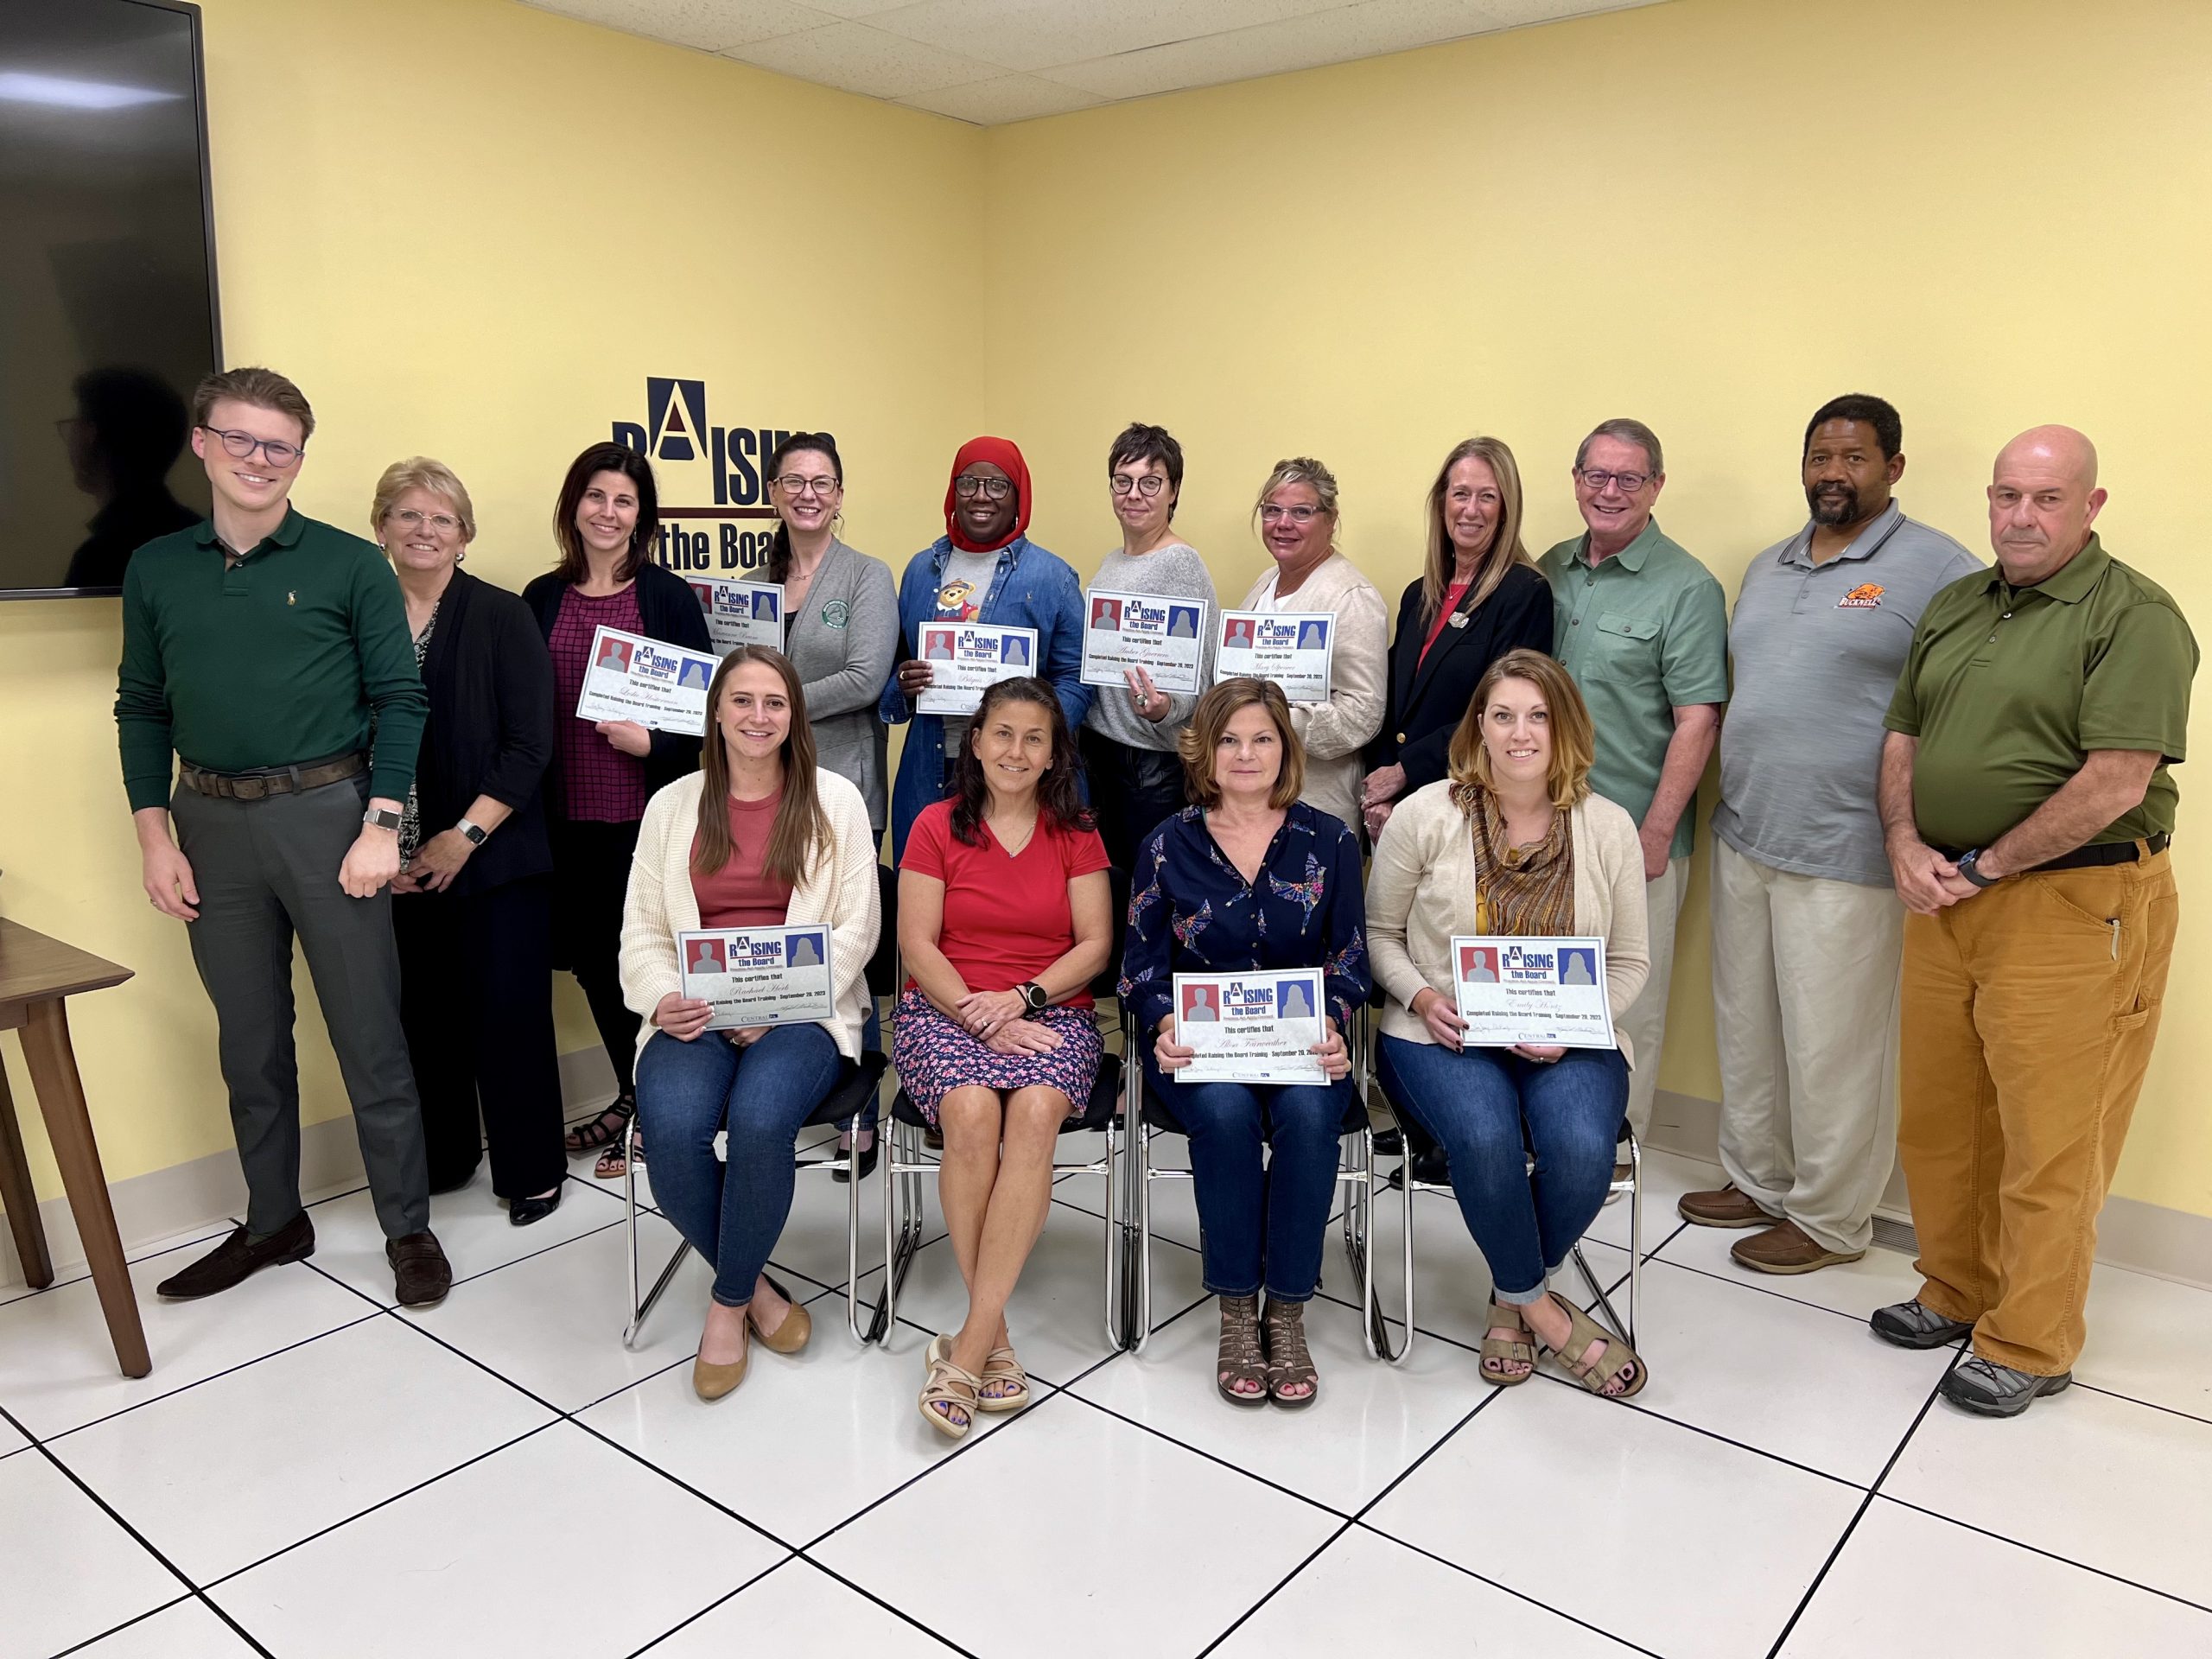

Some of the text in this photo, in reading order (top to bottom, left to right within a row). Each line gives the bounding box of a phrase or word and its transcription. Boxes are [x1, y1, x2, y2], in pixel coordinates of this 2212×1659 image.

[658, 523, 779, 570] the Boa
[715, 586, 749, 605] RAISING
[1839, 597, 1876, 606] BUCKNELL
[1124, 601, 1166, 621] RAISING
[1257, 620, 1296, 637] RAISING
[958, 631, 998, 650] RAISING
[634, 646, 677, 671] RAISING
[651, 668, 669, 679] Board
[729, 937, 782, 957] RAISING
[738, 957, 774, 967] the Board
[1502, 946, 1554, 968] RAISING
[1525, 970, 1547, 979] Board
[1224, 982, 1273, 1004] RAISING
[1231, 1006, 1266, 1016] the Board
